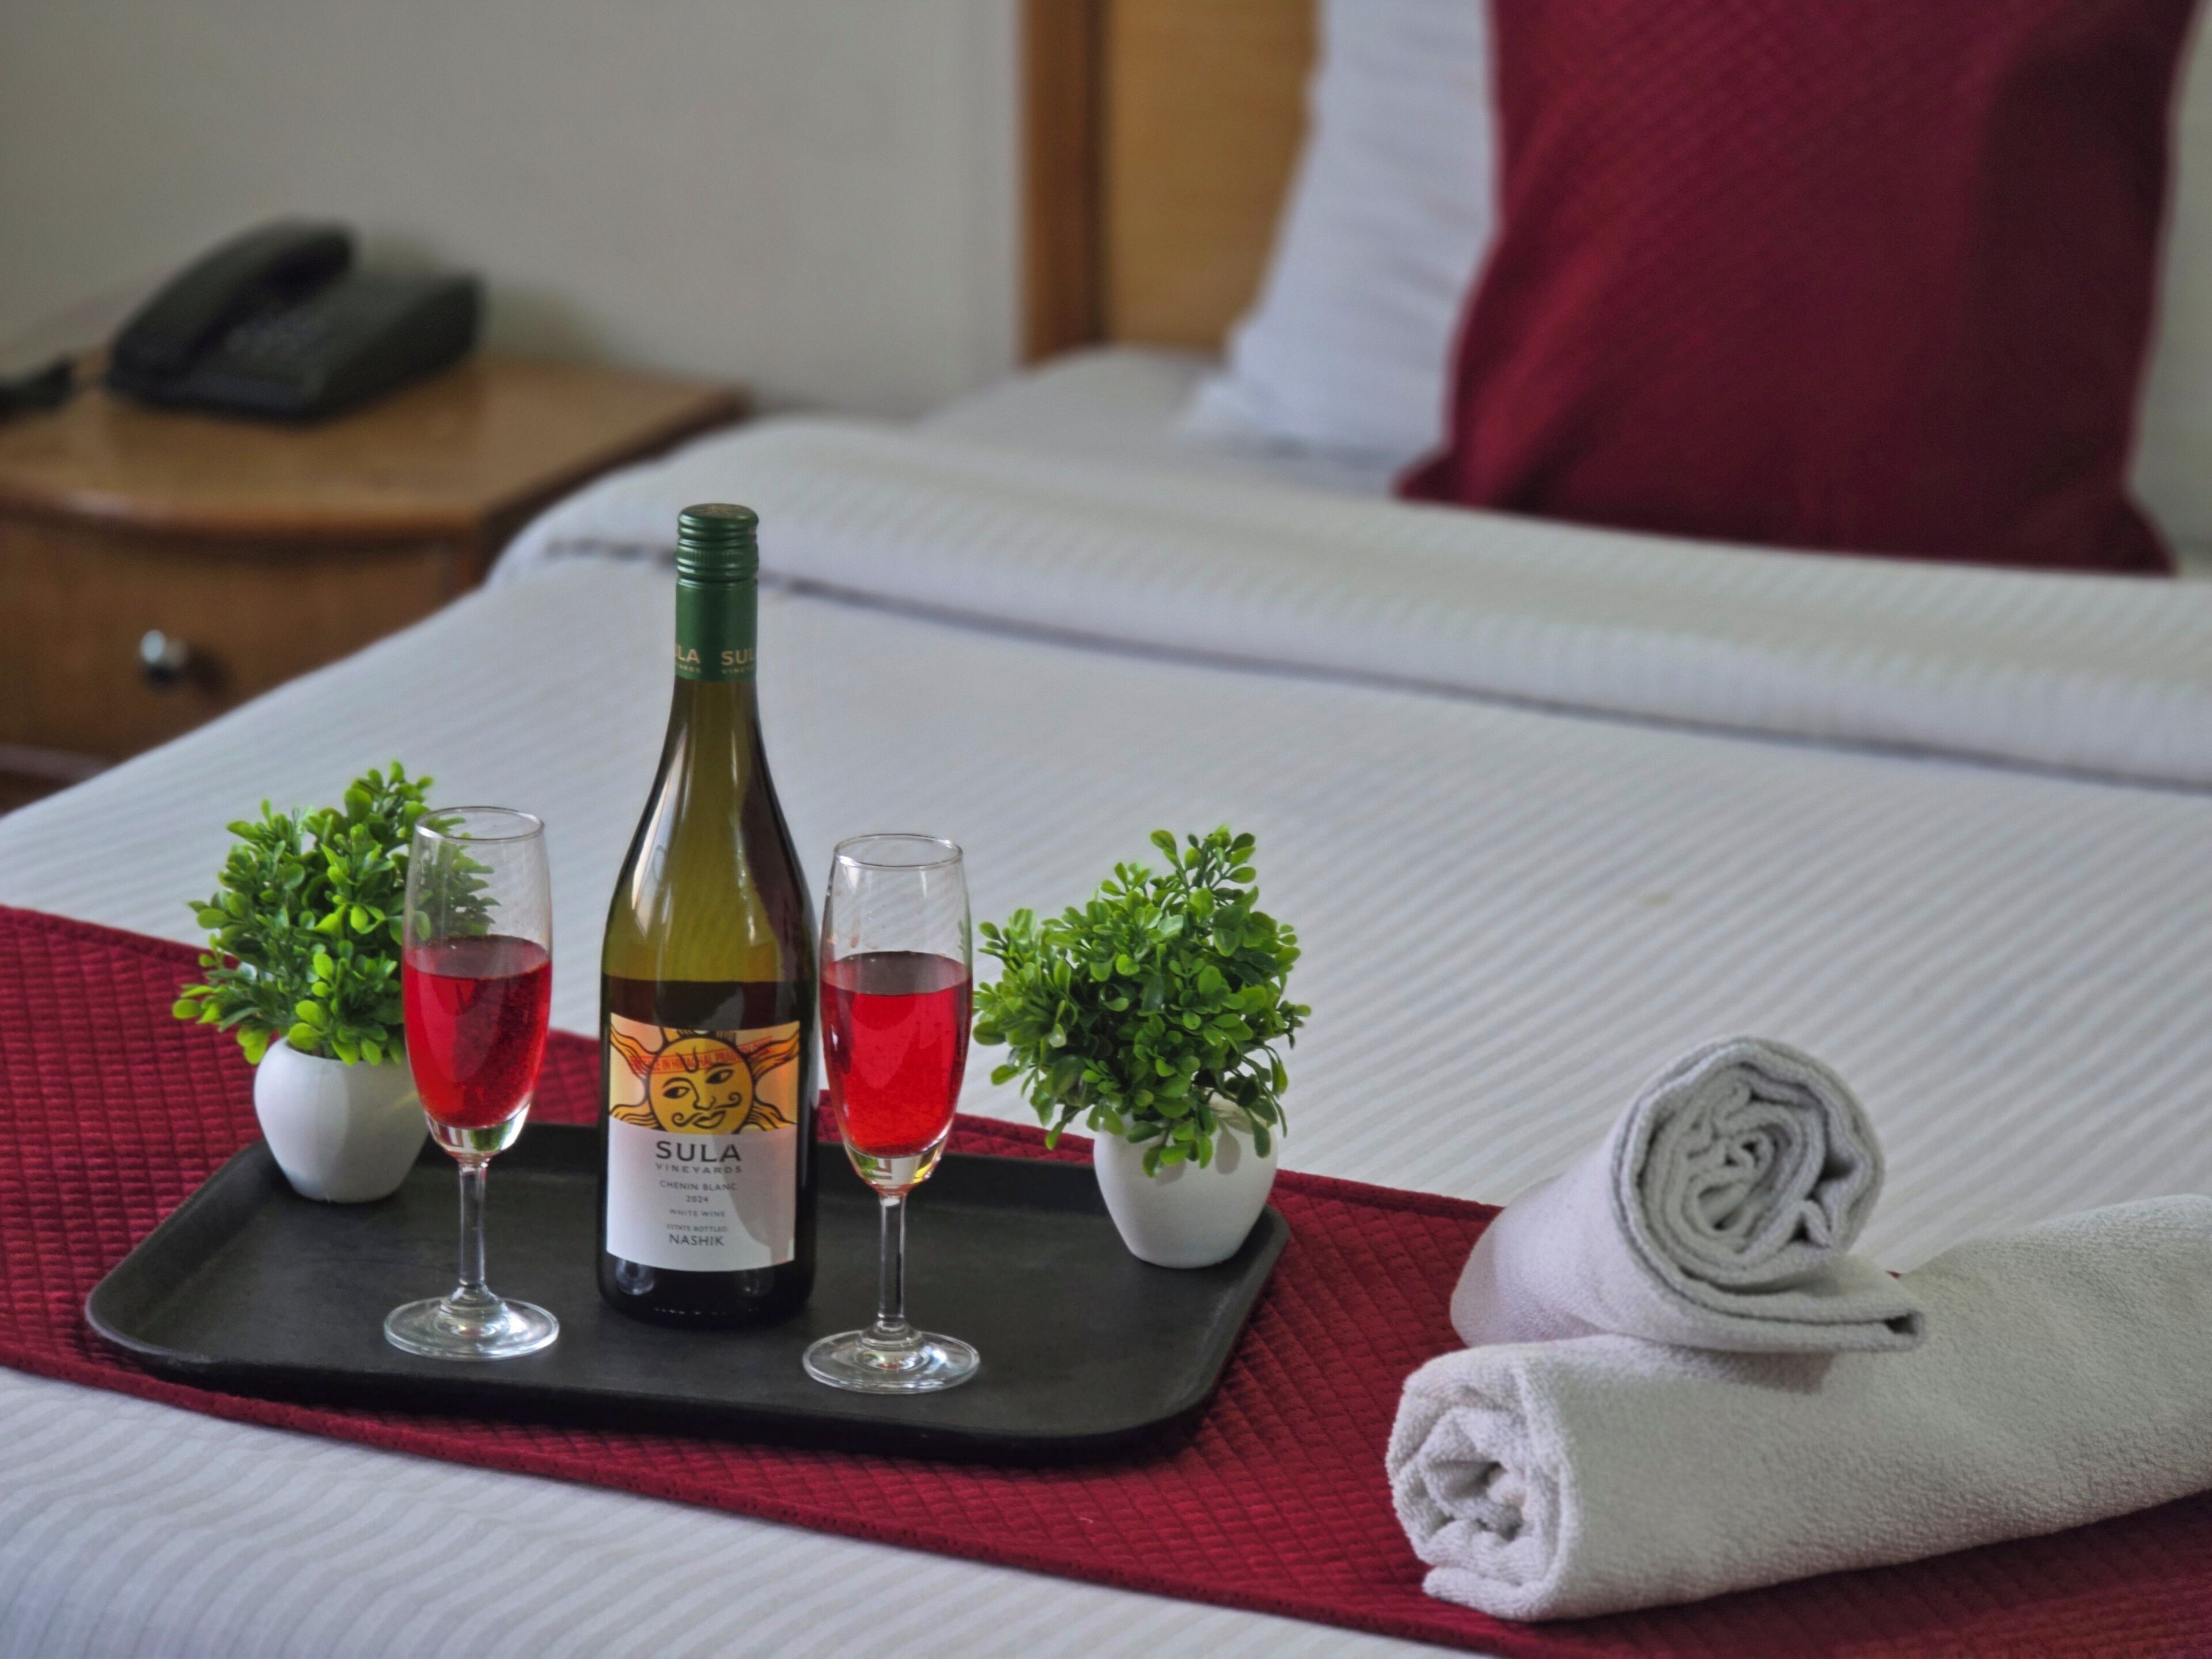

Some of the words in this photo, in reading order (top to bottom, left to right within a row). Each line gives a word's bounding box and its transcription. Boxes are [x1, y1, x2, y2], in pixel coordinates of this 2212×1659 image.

[656, 1140, 742, 1162] SULA
[656, 1162, 743, 1174] VINEYARDS
[660, 1180, 699, 1191] CHENIN
[702, 1183, 738, 1191] BLANC
[686, 1195, 709, 1203] 2024
[669, 1209, 698, 1217] WHITE
[669, 1233, 725, 1247] NASHIK
